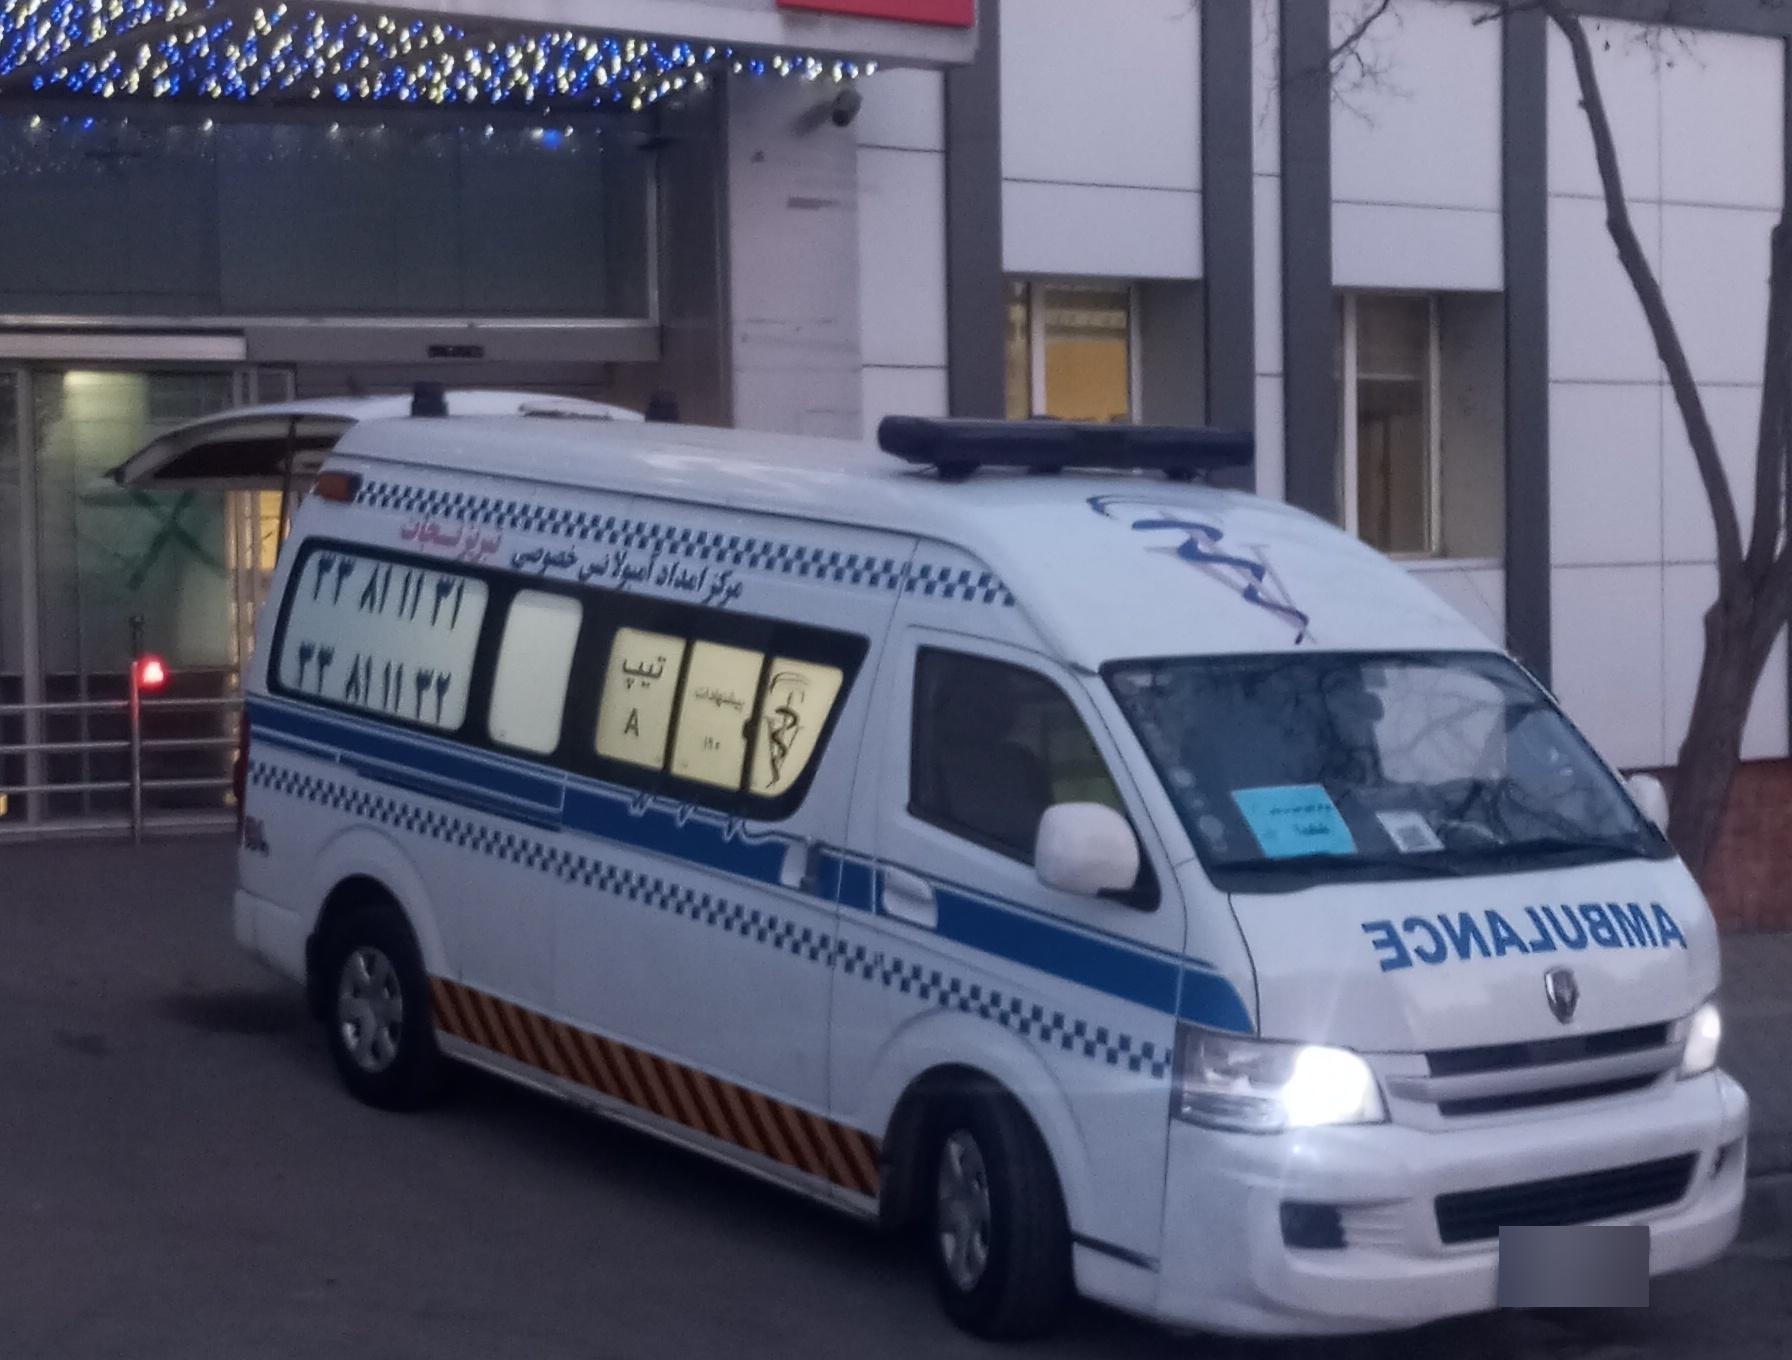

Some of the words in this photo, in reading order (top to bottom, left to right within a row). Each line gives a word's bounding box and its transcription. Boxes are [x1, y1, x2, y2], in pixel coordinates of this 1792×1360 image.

[510, 544, 579, 578] خصوصی
[655, 561, 709, 593] امداد
[701, 569, 743, 608] مرکز
[622, 656, 667, 689] تیپ
[624, 708, 640, 737] A
